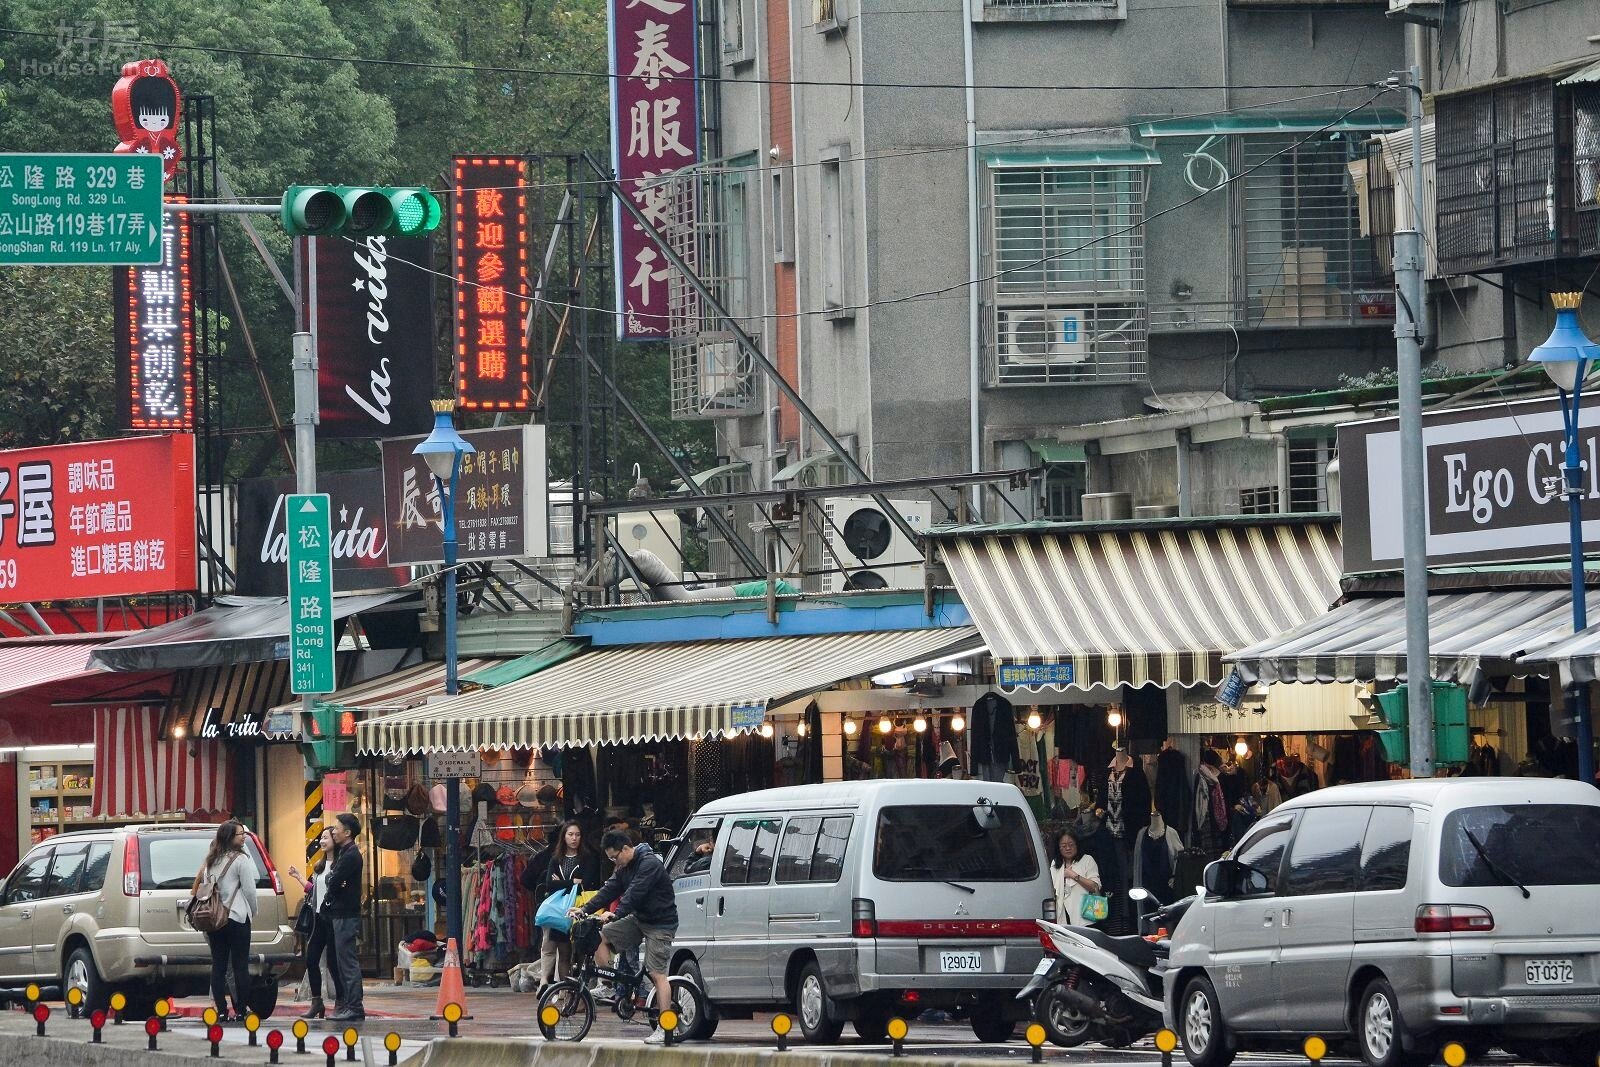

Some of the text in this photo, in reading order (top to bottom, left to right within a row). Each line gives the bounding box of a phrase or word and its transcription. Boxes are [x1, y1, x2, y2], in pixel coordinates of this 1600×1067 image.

[12, 193, 126, 208] SongLong Rd. 329 Ln.
[50, 242, 66, 253] Rd.
[71, 242, 88, 253] 119
[92, 242, 106, 253] Ln.
[109, 241, 121, 252] 17
[125, 241, 142, 255] Aly.
[476, 188, 506, 379] 歡迎參觀選購
[345, 357, 391, 425] la
[68, 459, 115, 494] 調味品
[1443, 453, 1514, 524] Ego
[69, 501, 132, 536] 年節禮品
[468, 530, 507, 551] 批發零售
[71, 539, 165, 577] 進口糖果餅乾
[298, 525, 323, 620] 松隆路
[295, 623, 324, 636] Song
[296, 636, 324, 648] Long
[296, 649, 314, 659] Rd.
[296, 662, 311, 673] 341
[297, 680, 312, 690] 331
[202, 707, 220, 738] la
[227, 713, 261, 737] vita
[1526, 965, 1573, 981] 6T-0372
